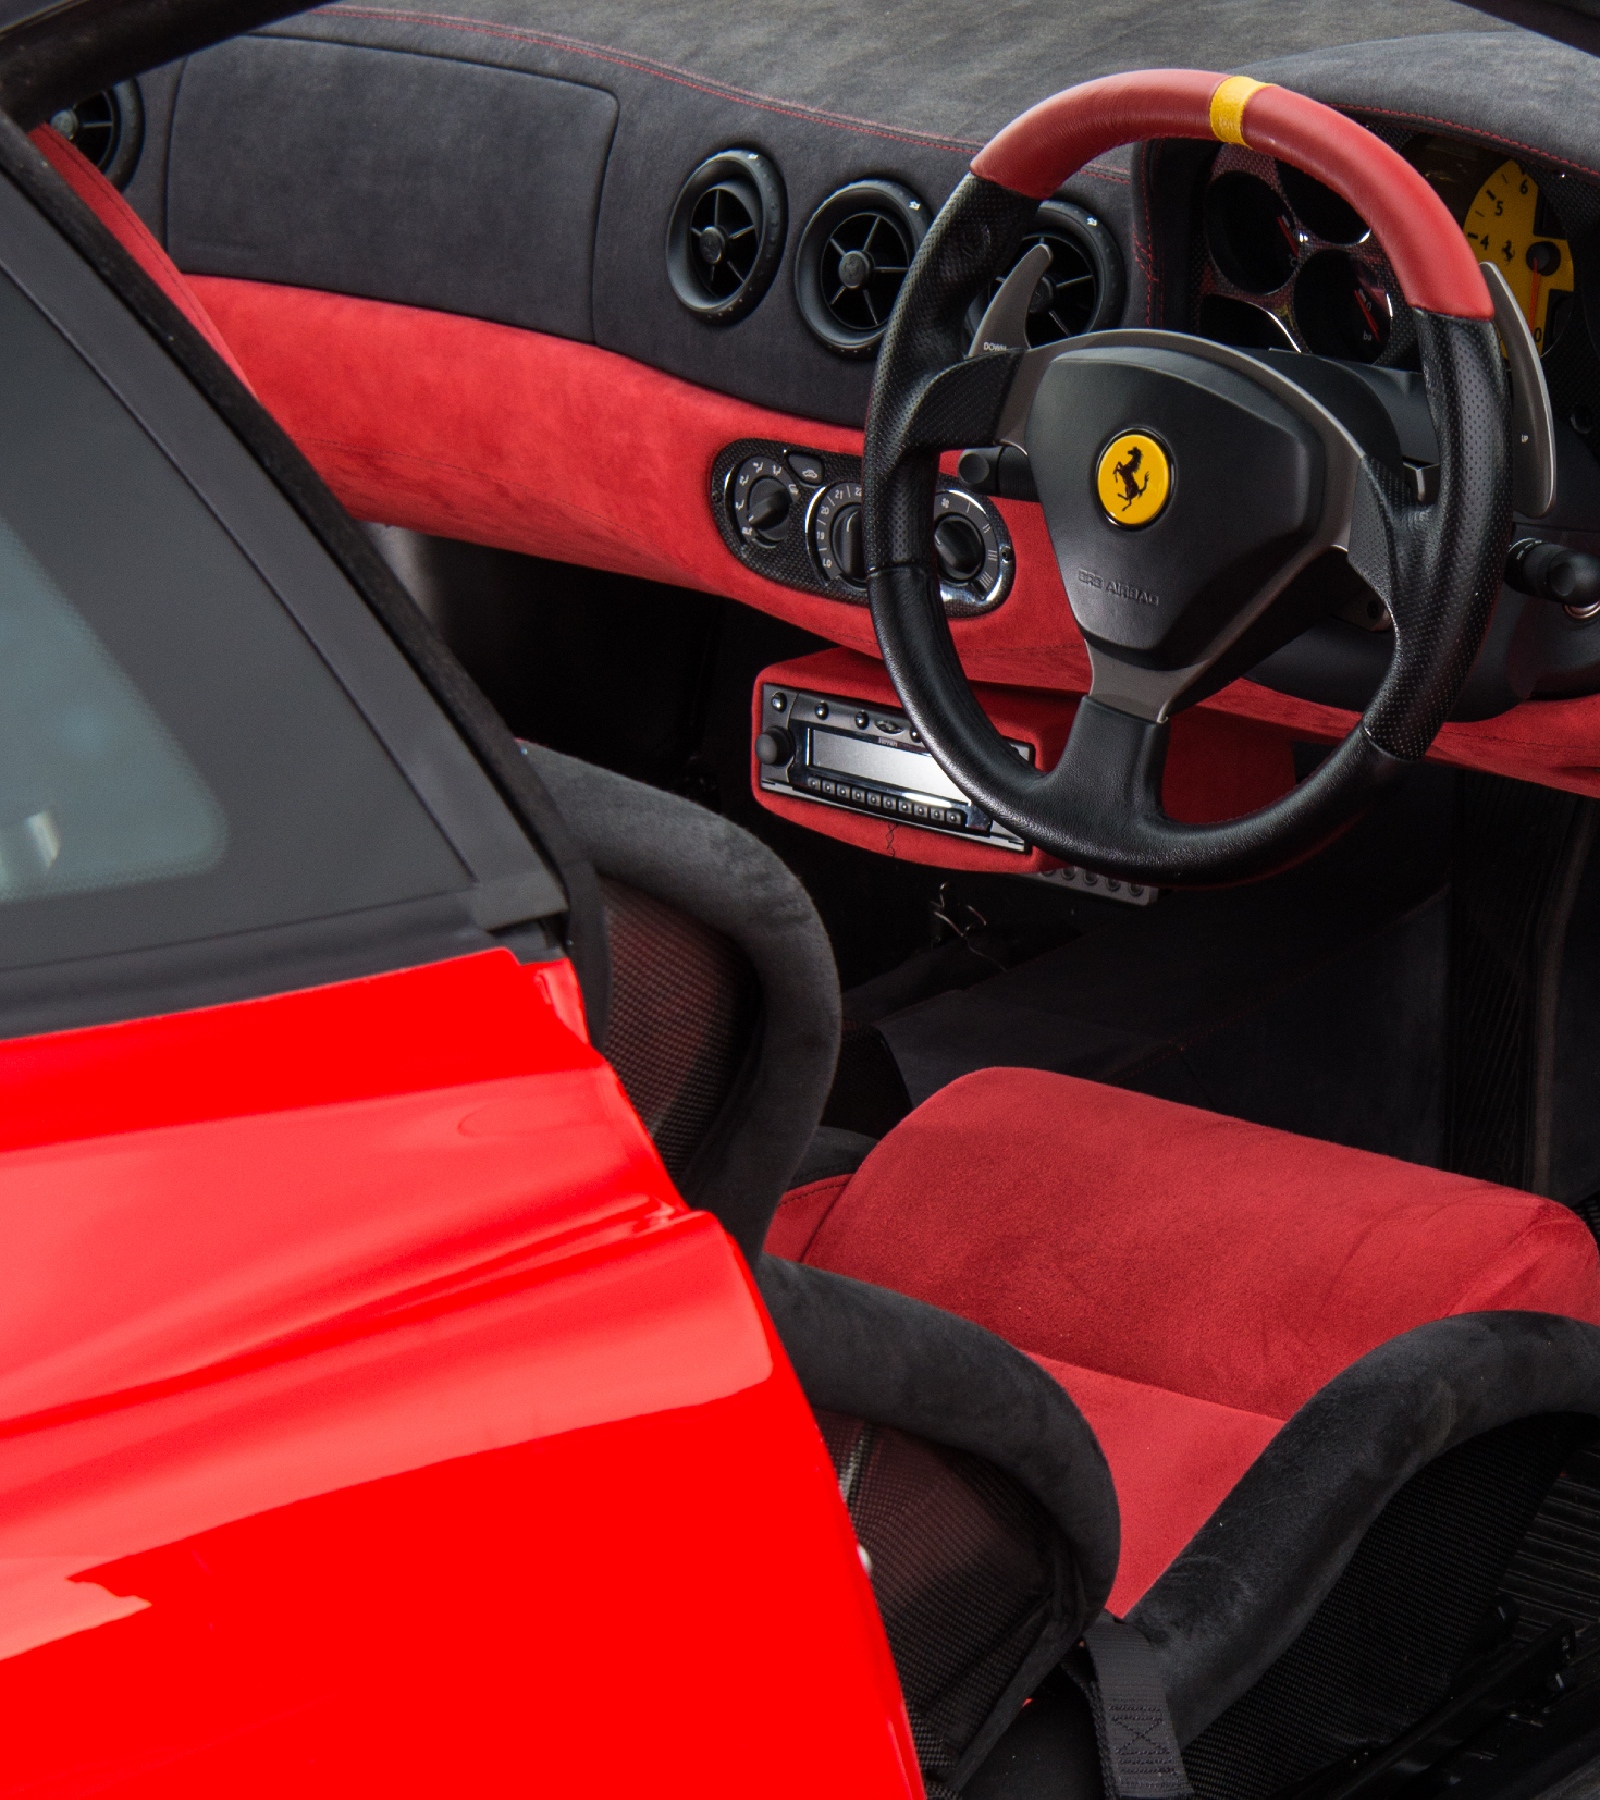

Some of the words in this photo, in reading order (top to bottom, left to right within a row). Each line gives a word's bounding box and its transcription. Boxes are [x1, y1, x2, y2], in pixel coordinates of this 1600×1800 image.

[1519, 179, 1529, 195] 6
[1495, 201, 1504, 216] 5
[1480, 235, 1489, 250] 4
[1534, 327, 1542, 342] 0
[835, 489, 843, 499] 21
[821, 506, 829, 515] 20
